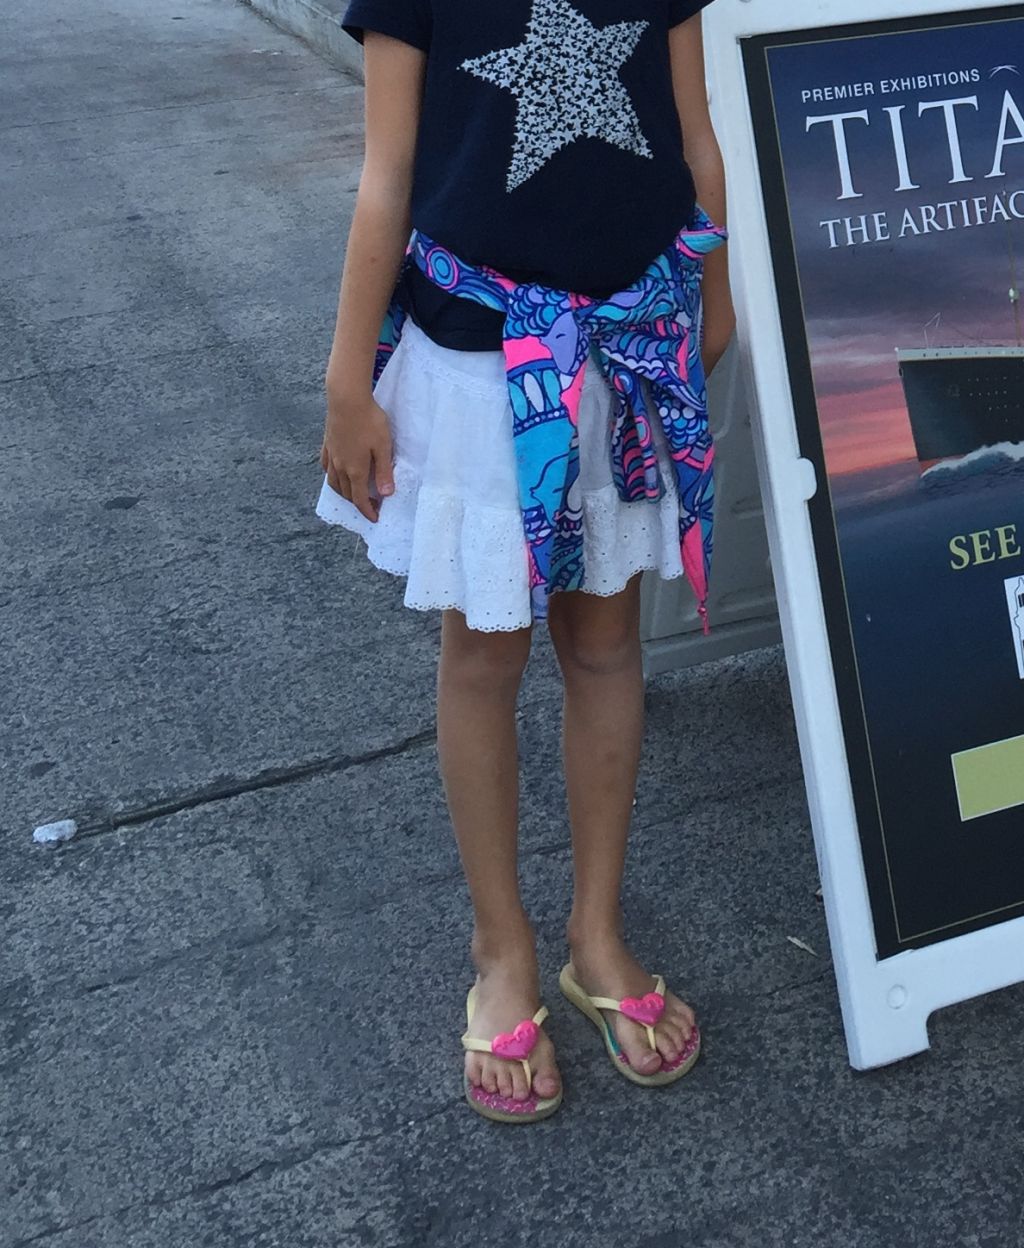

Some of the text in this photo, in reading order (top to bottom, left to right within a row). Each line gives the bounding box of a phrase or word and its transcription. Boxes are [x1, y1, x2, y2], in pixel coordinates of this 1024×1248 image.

[801, 68, 980, 103] PREMIER EXHIBITIONS
[819, 211, 890, 249] THE
[949, 524, 1021, 570] SEE
